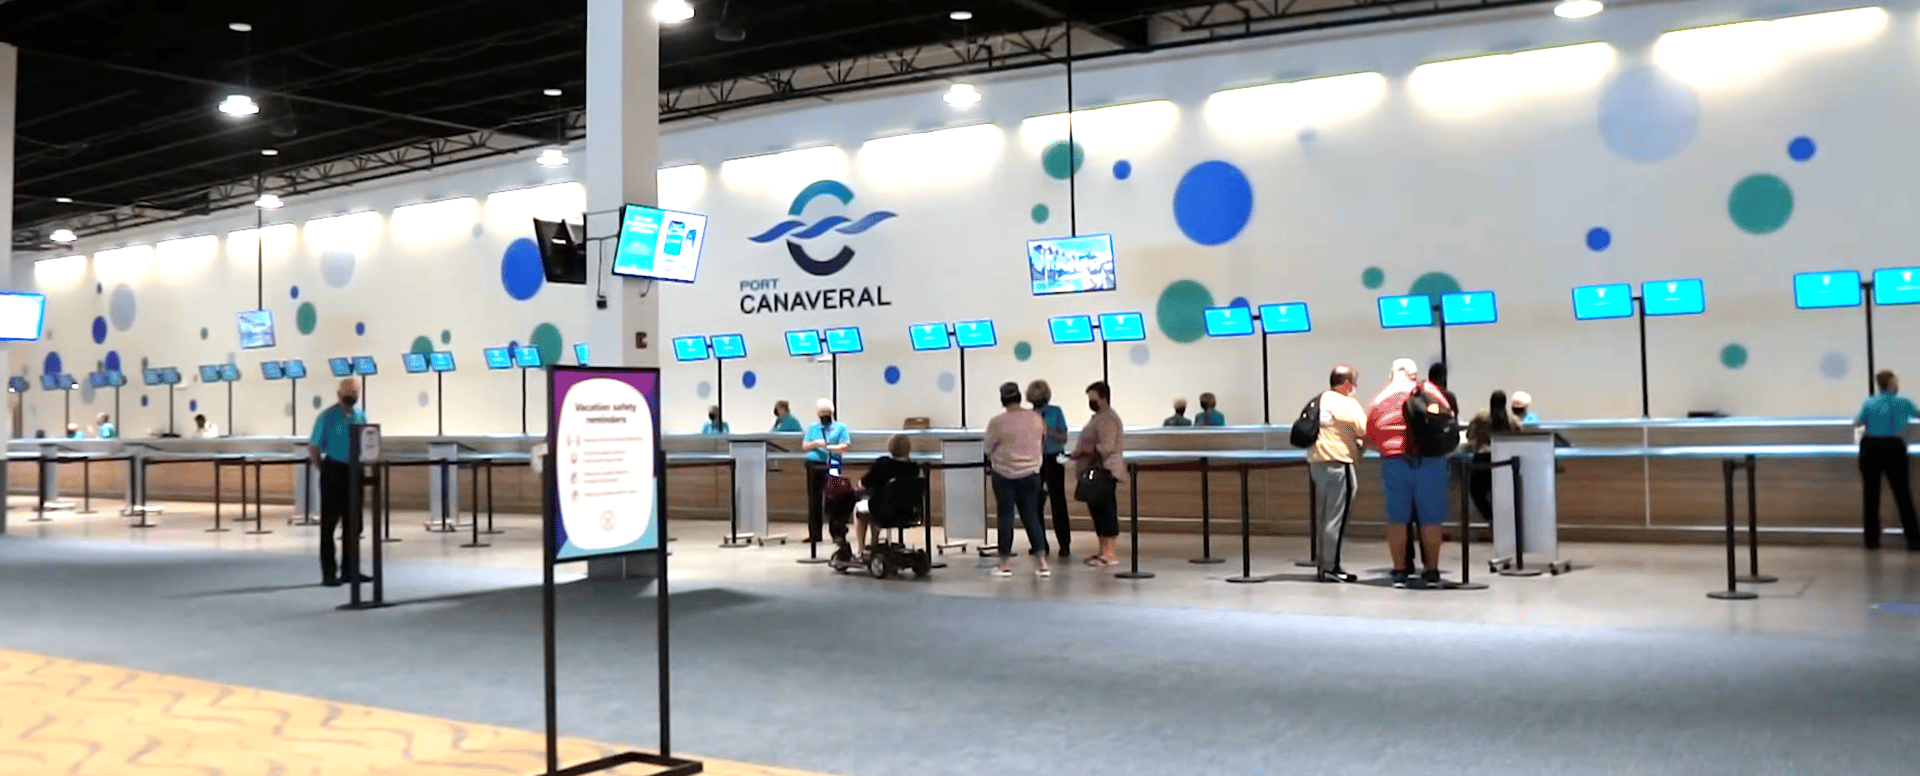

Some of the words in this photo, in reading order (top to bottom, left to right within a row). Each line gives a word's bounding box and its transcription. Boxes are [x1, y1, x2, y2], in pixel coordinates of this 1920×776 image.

[740, 278, 779, 291] PORT
[740, 285, 892, 314] CANAVERAL
[574, 403, 610, 411] Vacation
[613, 403, 636, 412] safety
[586, 415, 627, 423] reminders
